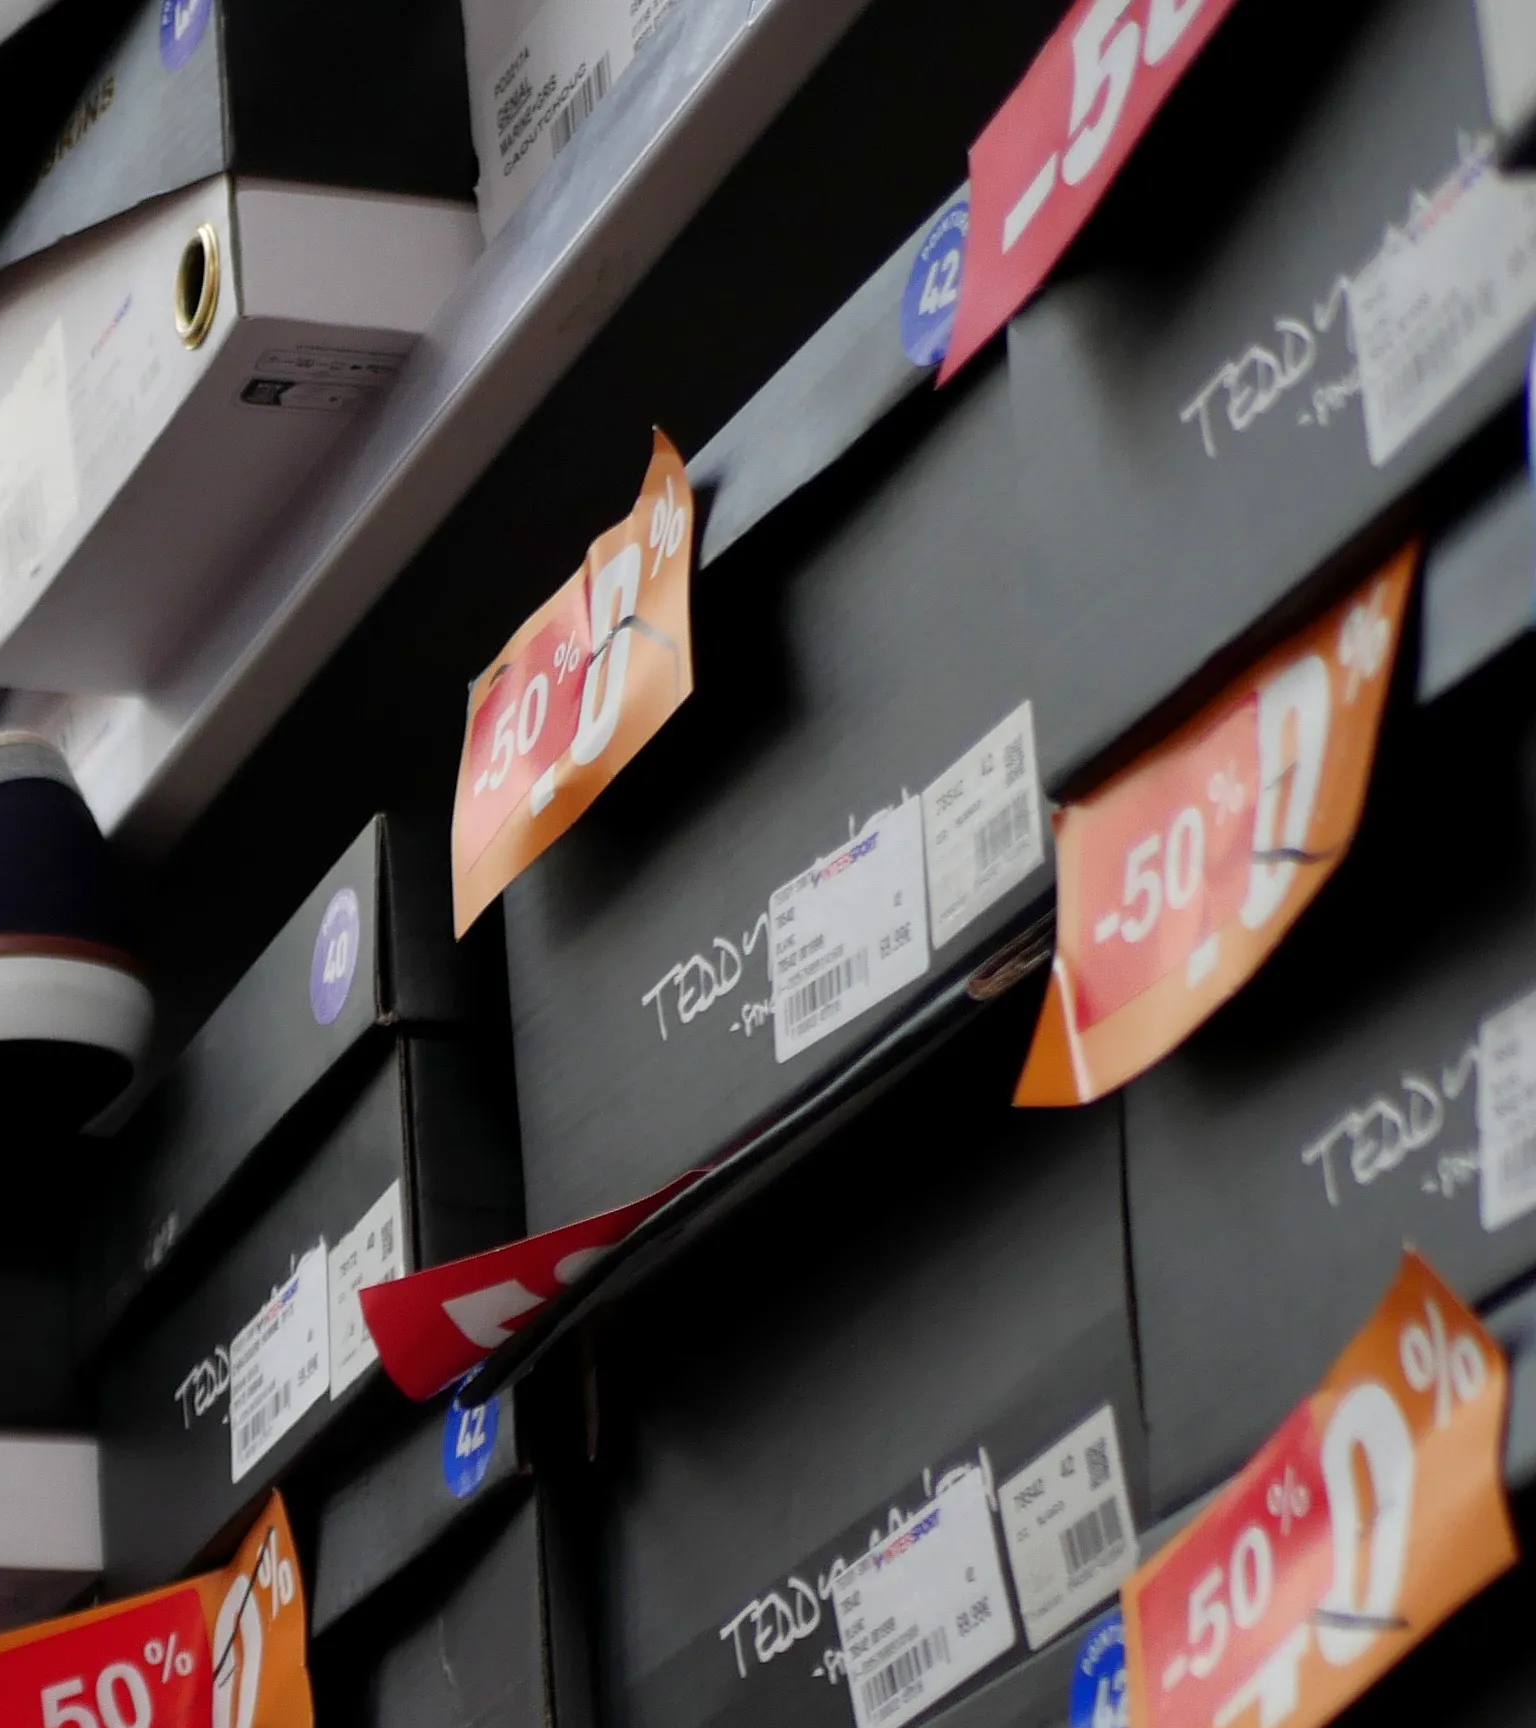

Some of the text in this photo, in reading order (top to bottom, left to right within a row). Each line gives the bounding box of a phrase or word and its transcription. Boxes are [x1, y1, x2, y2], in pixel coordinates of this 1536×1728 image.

[918, 249, 961, 316] 42
[474, 630, 581, 797] -50%
[1094, 758, 1246, 944] -50%
[455, 1402, 487, 1459] 42
[1161, 1463, 1311, 1693] -50%
